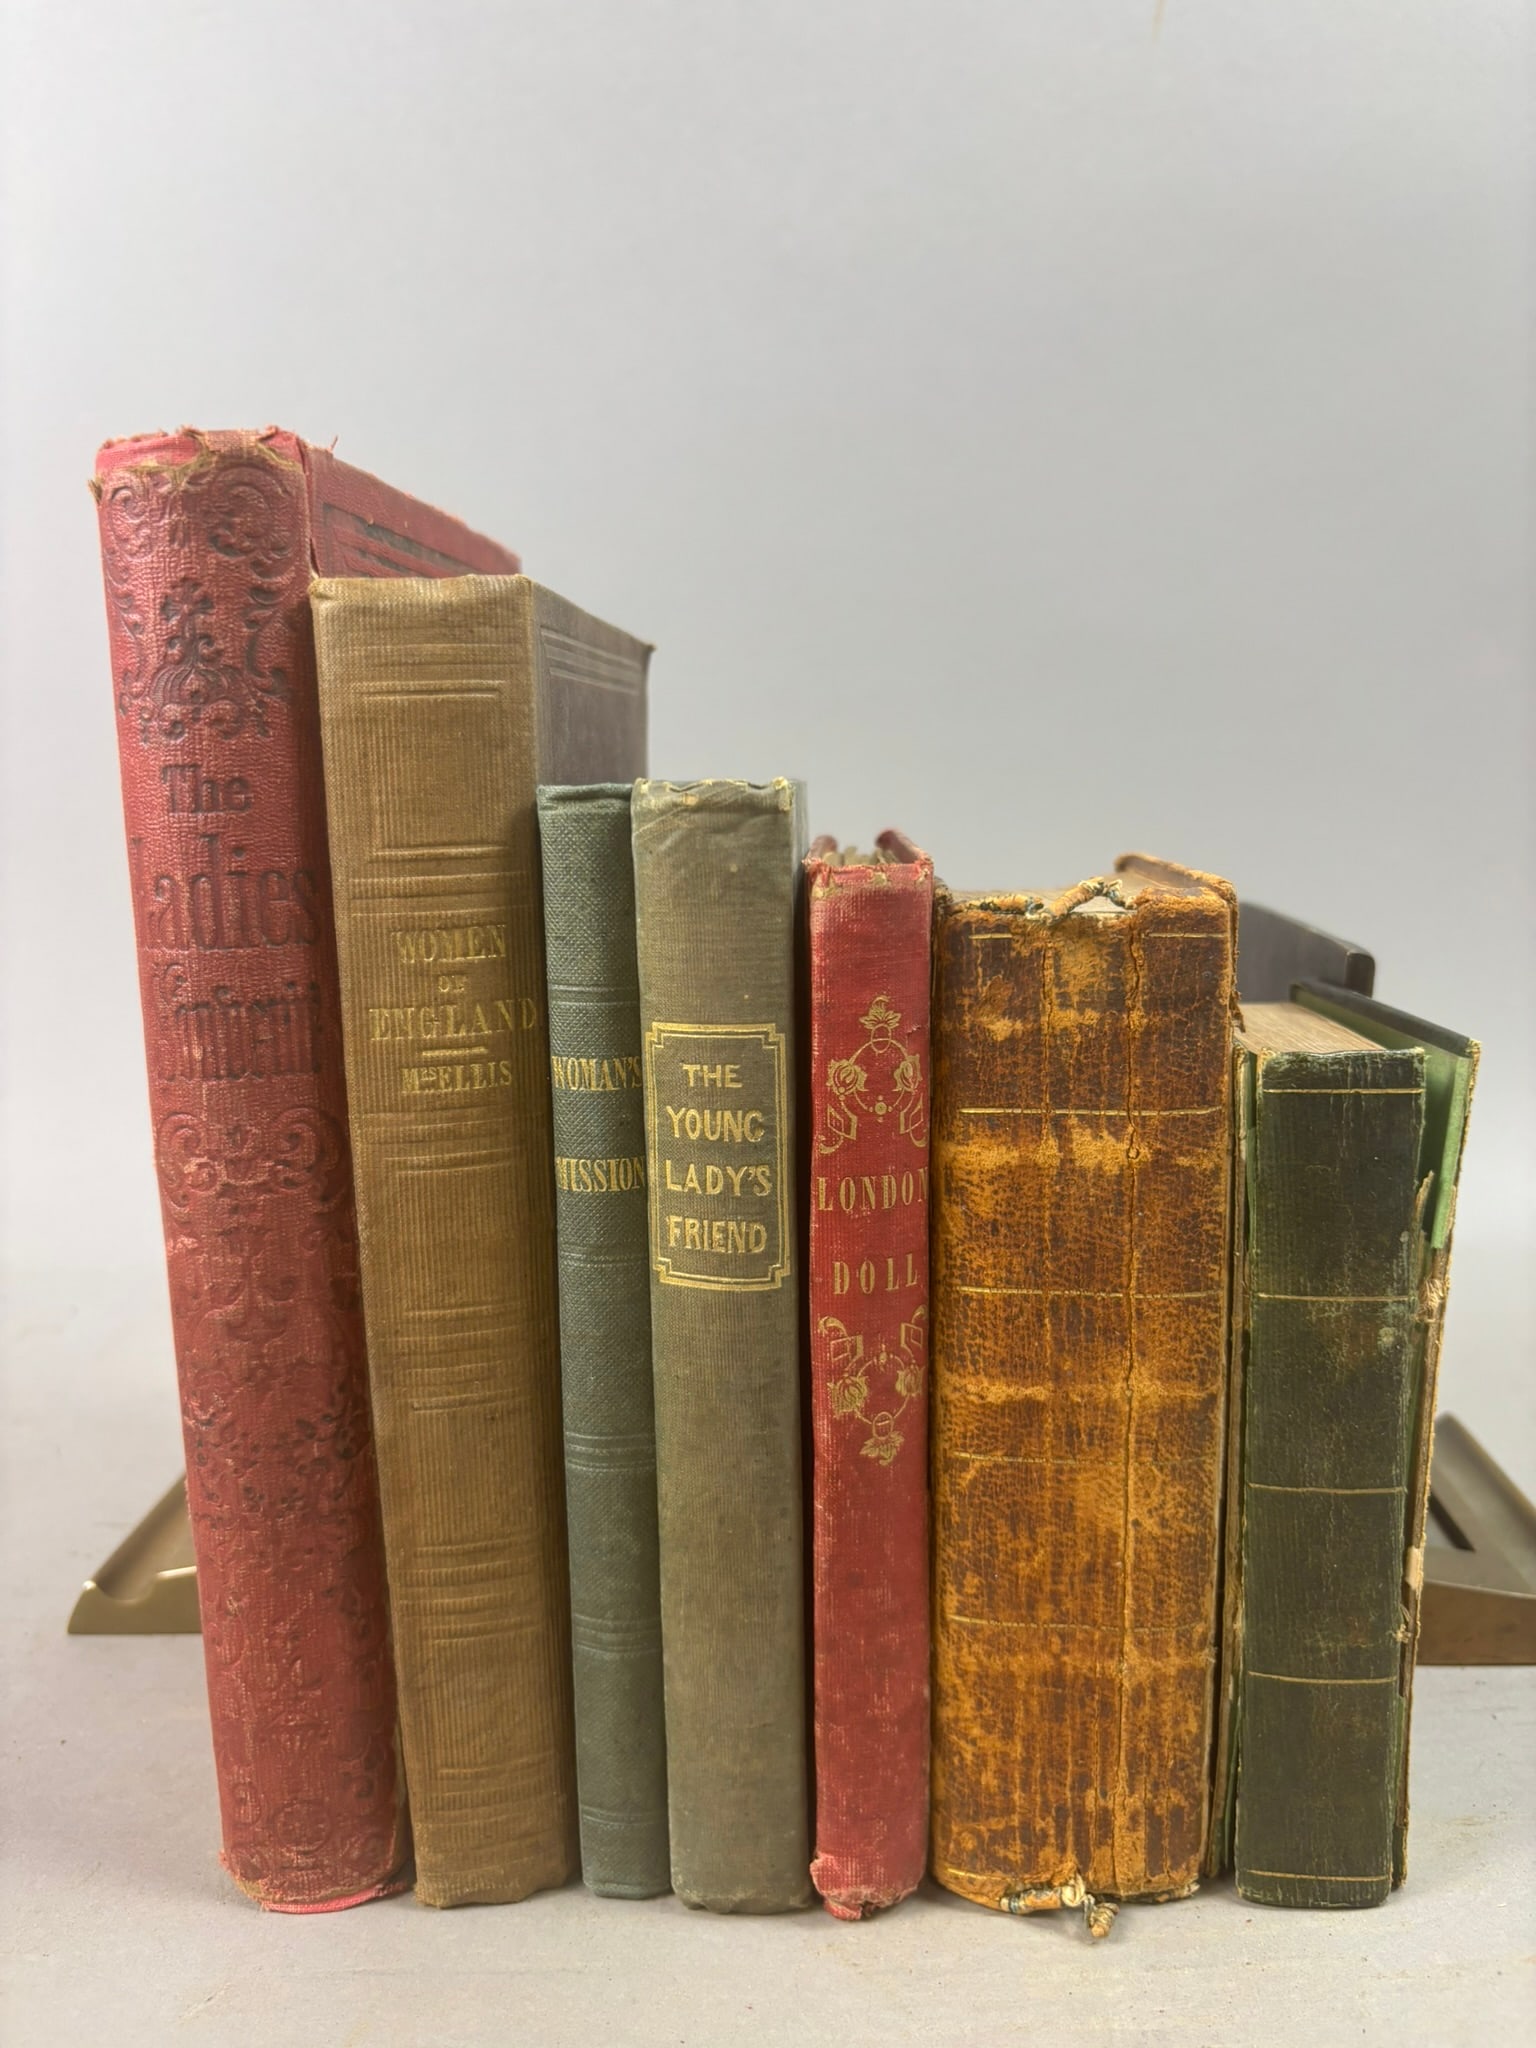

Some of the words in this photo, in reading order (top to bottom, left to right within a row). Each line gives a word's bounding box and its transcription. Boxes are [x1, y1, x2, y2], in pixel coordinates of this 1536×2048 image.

[161, 764, 253, 813] The
[391, 924, 507, 963] WOMEN
[369, 998, 538, 1041] ENGLAND
[437, 1060, 513, 1091] ELLIS
[552, 1055, 643, 1091] WOMAN'S
[682, 1063, 743, 1088] THE
[665, 1105, 765, 1142] YOUNG
[555, 1156, 646, 1192] MISSION
[665, 1159, 773, 1197] LADY'S
[816, 1167, 929, 1212] LONDON
[667, 1215, 768, 1253] FRIEND
[832, 1253, 918, 1295] DOLL
